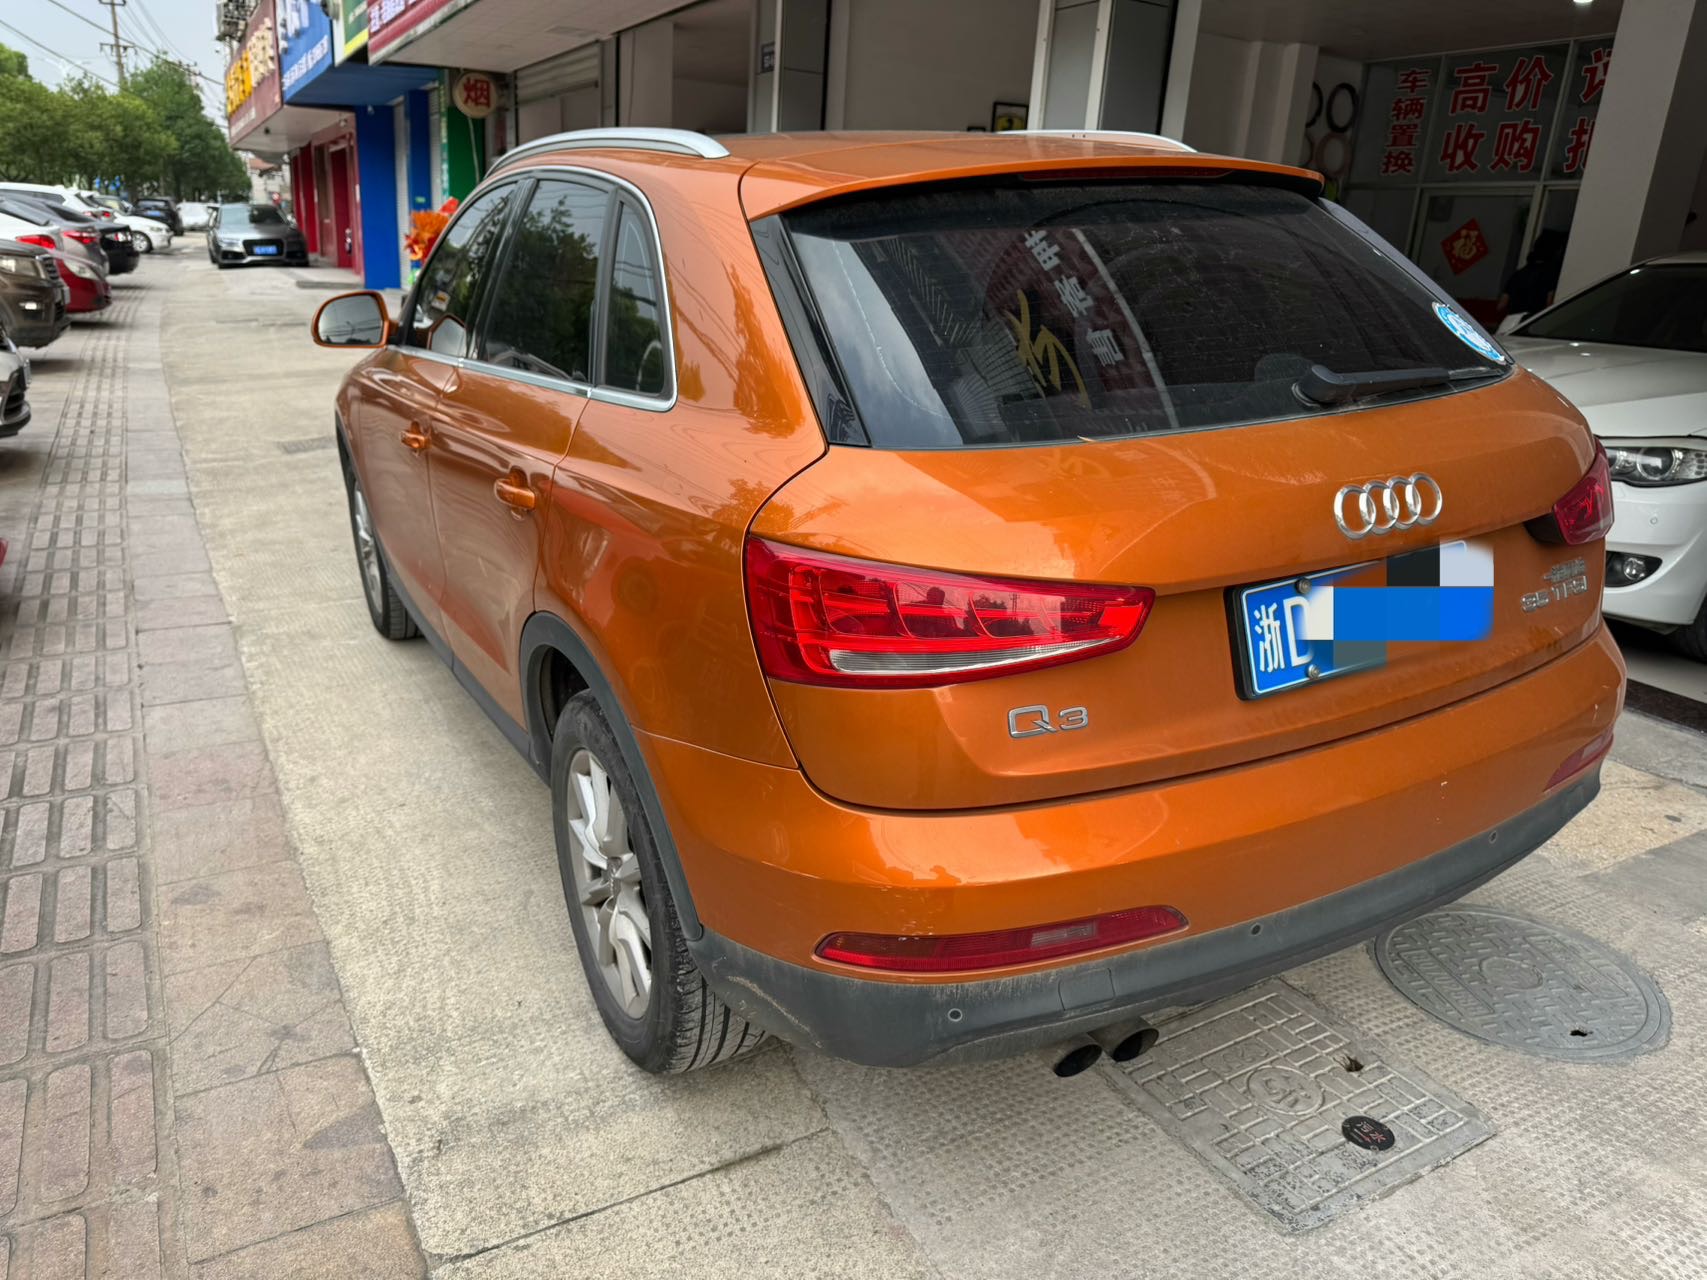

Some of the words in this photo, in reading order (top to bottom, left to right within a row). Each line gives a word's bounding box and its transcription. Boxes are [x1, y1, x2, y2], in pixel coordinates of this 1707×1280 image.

[463, 77, 491, 108] 烟
[1448, 56, 1553, 115] 高价
[1380, 68, 1432, 176] 车辆置换
[1440, 119, 1541, 173] 收购
[1451, 228, 1480, 260] 福
[1008, 704, 1088, 738] Q3
